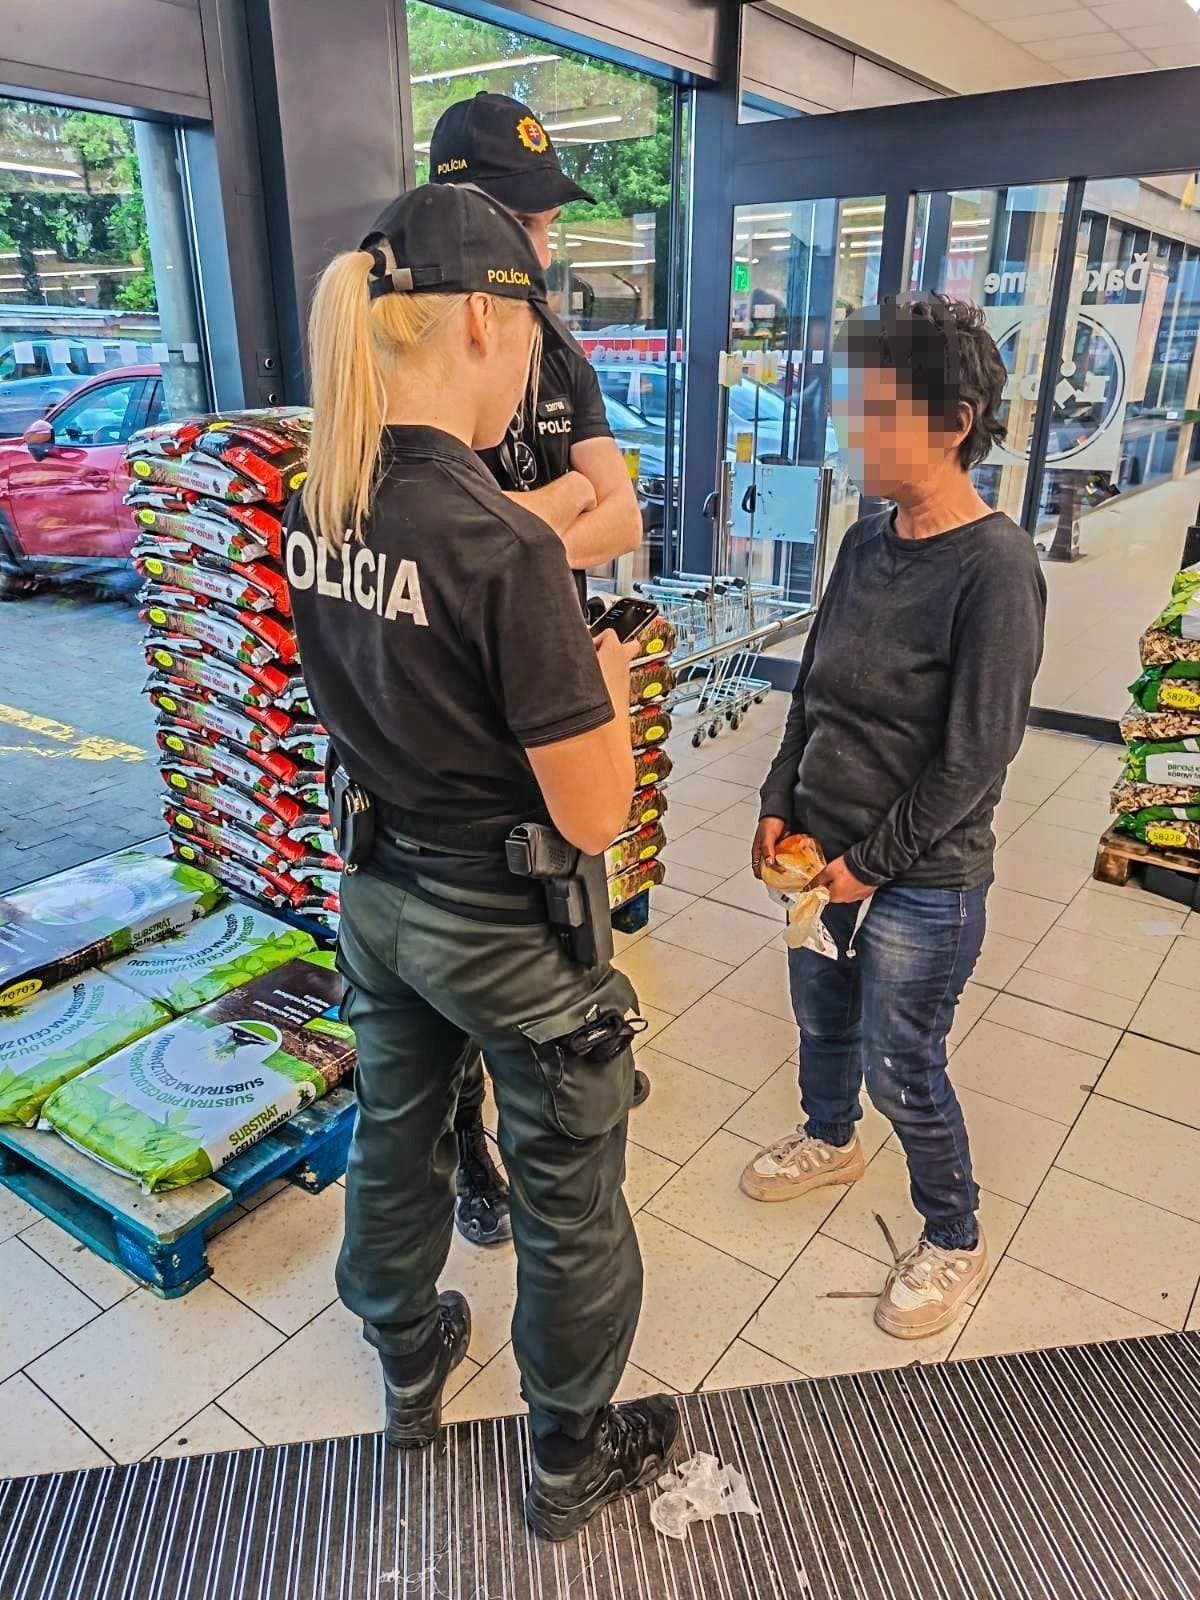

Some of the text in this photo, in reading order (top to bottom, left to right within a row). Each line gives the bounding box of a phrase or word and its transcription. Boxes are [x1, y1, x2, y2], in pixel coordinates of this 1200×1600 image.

[437, 158, 467, 175] POLÍCIA
[487, 267, 531, 286] POLÍCIA
[537, 416, 572, 435] POLÍC
[286, 528, 429, 626] OLÍCIA
[1, 982, 37, 1003] 70703
[229, 1104, 279, 1146] SUBSTRÁT
[222, 1151, 236, 1165] NA
